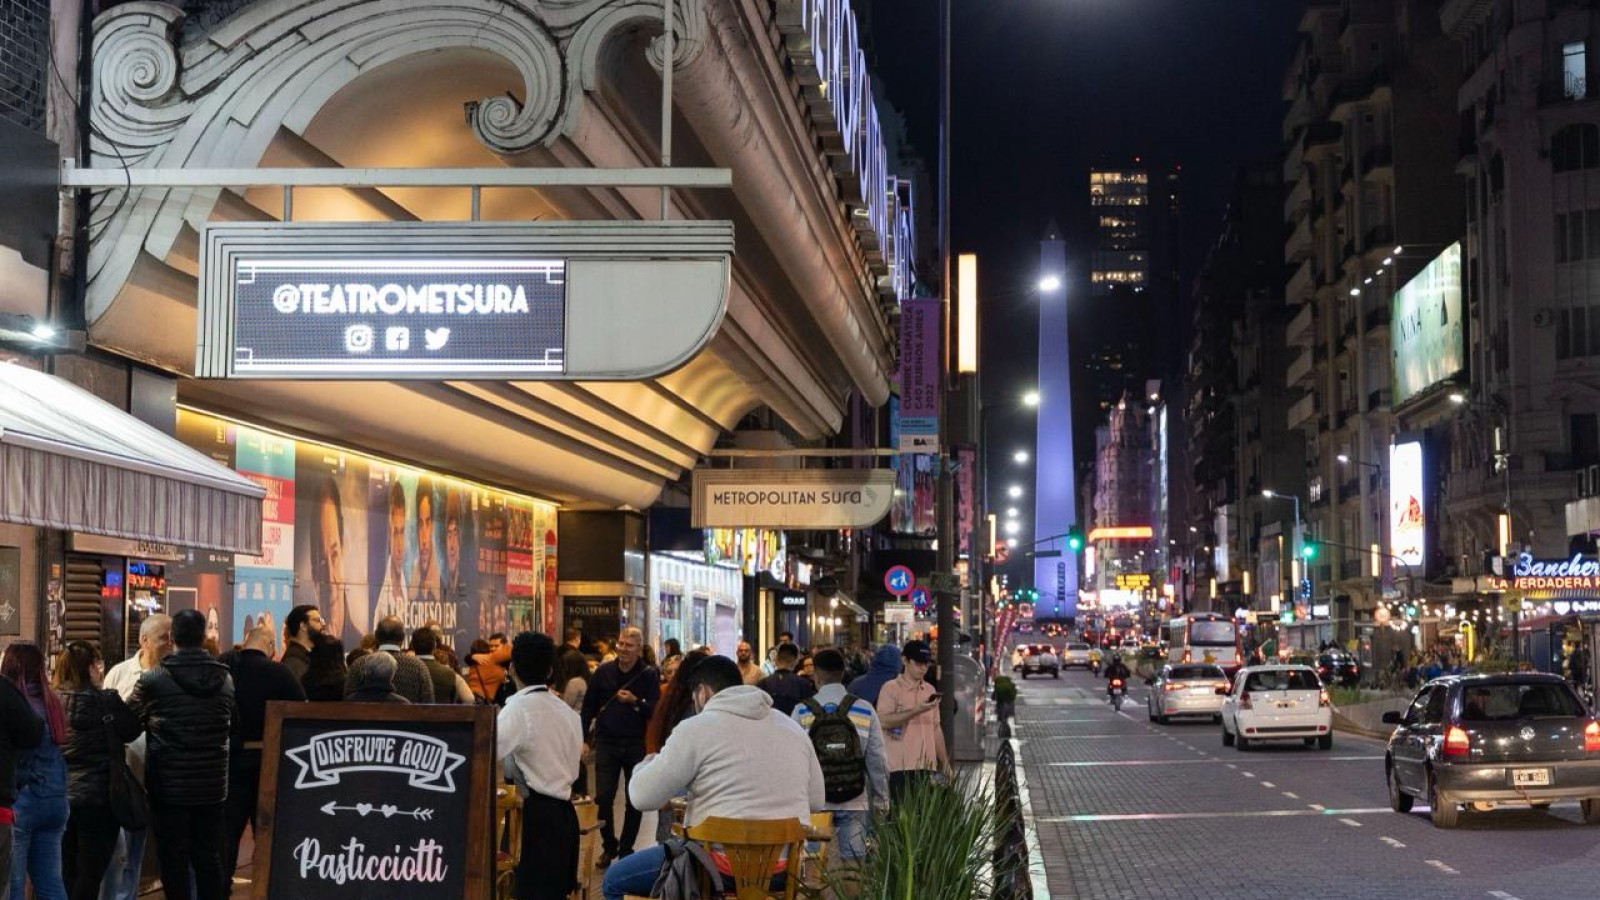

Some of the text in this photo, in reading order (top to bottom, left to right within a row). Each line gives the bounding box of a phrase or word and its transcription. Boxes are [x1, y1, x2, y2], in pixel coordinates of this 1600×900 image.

[273, 284, 529, 314] @TEATROMETSURA
[915, 309, 923, 410] C40 BUENOS AIRES
[904, 365, 912, 410] CUMBRE
[925, 384, 934, 409] 2022
[714, 491, 862, 505] METROPOLITAN sura
[315, 736, 443, 771] DISFRUTE AQUI
[293, 836, 449, 885] Pasticciotti
